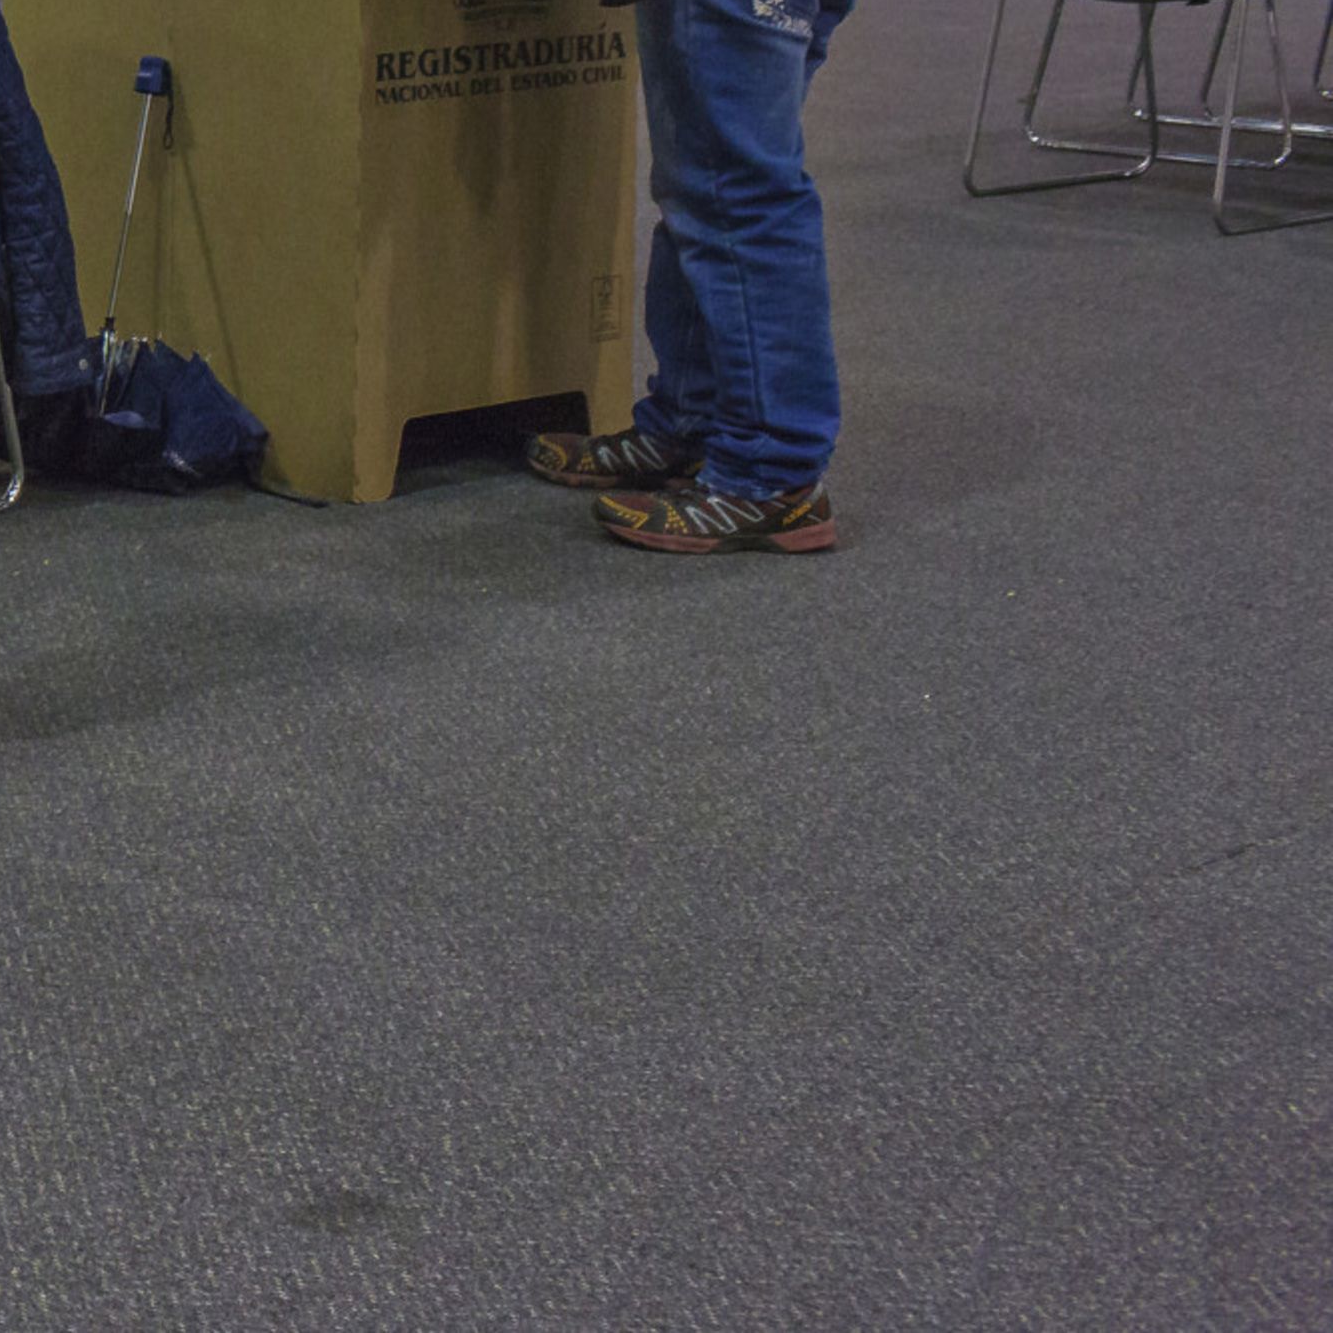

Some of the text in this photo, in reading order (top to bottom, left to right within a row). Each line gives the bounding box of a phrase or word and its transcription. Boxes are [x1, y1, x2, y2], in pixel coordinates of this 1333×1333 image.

[375, 22, 626, 82] REGISTRADURÍA
[375, 64, 626, 105] NACIONAL DEL ESTADO CIVIL
